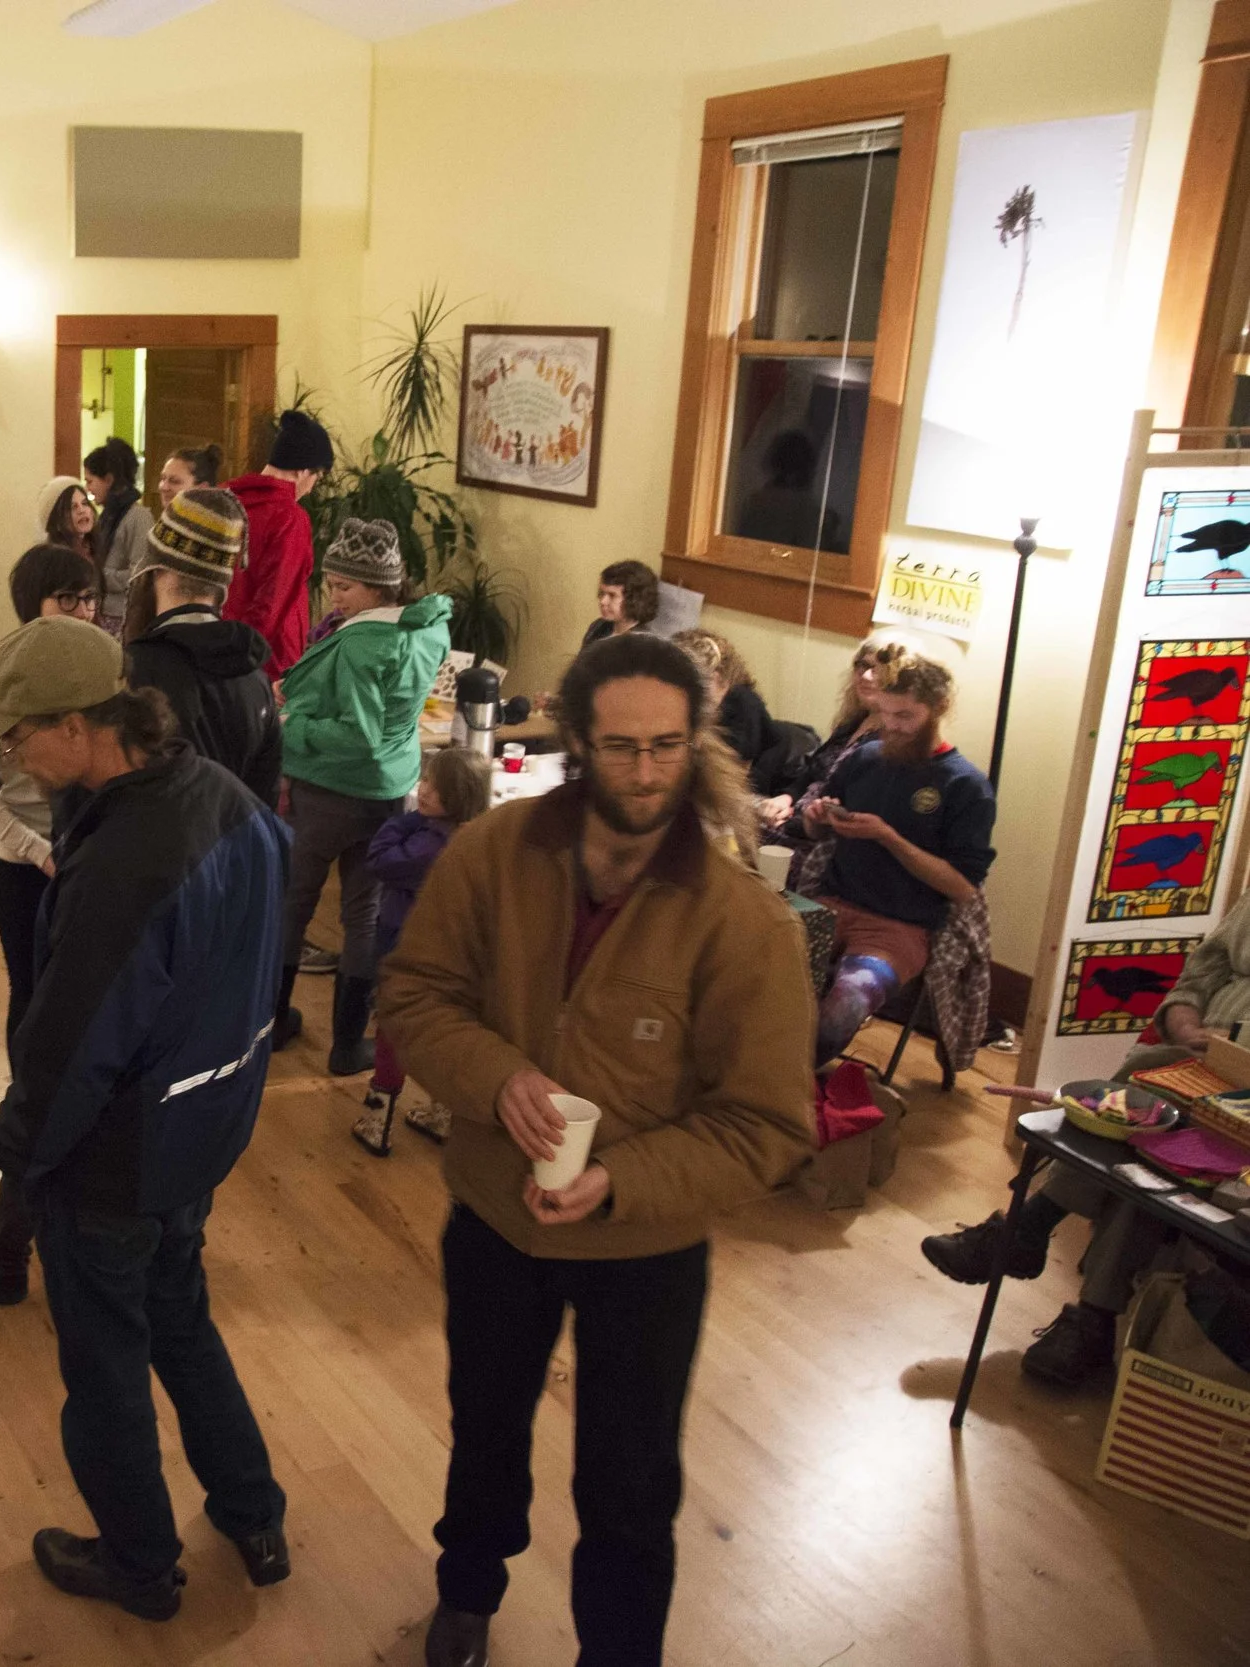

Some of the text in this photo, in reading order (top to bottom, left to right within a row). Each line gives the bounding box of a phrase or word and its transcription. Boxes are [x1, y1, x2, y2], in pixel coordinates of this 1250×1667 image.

[896, 553, 981, 583] terra
[892, 578, 977, 612] DIVINE
[889, 602, 971, 628] herbal products
[1197, 1390, 1250, 1414] ADOT
